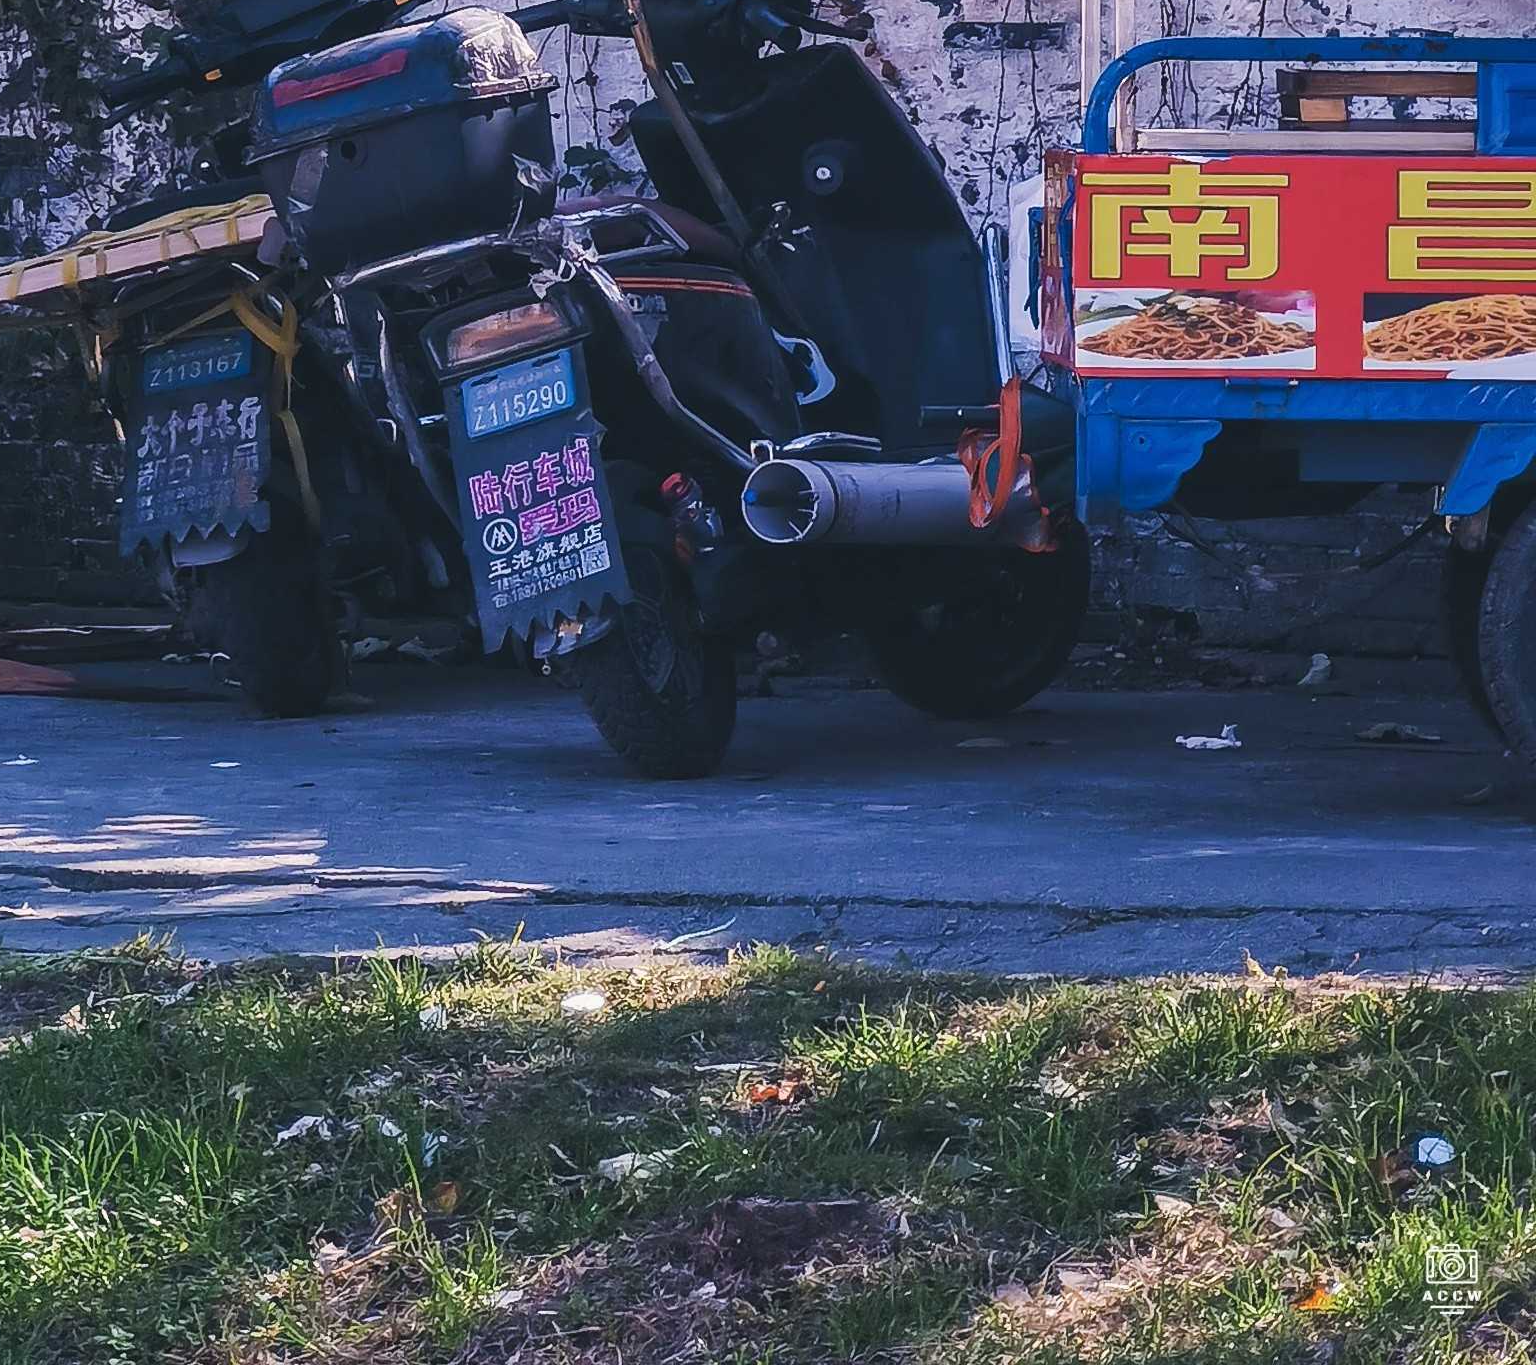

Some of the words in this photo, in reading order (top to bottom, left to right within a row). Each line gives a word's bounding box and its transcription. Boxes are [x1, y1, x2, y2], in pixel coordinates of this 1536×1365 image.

[473, 380, 566, 431] Z115290
[469, 437, 595, 520] 陆行车城
[488, 522, 603, 580] 王港旗舰店
